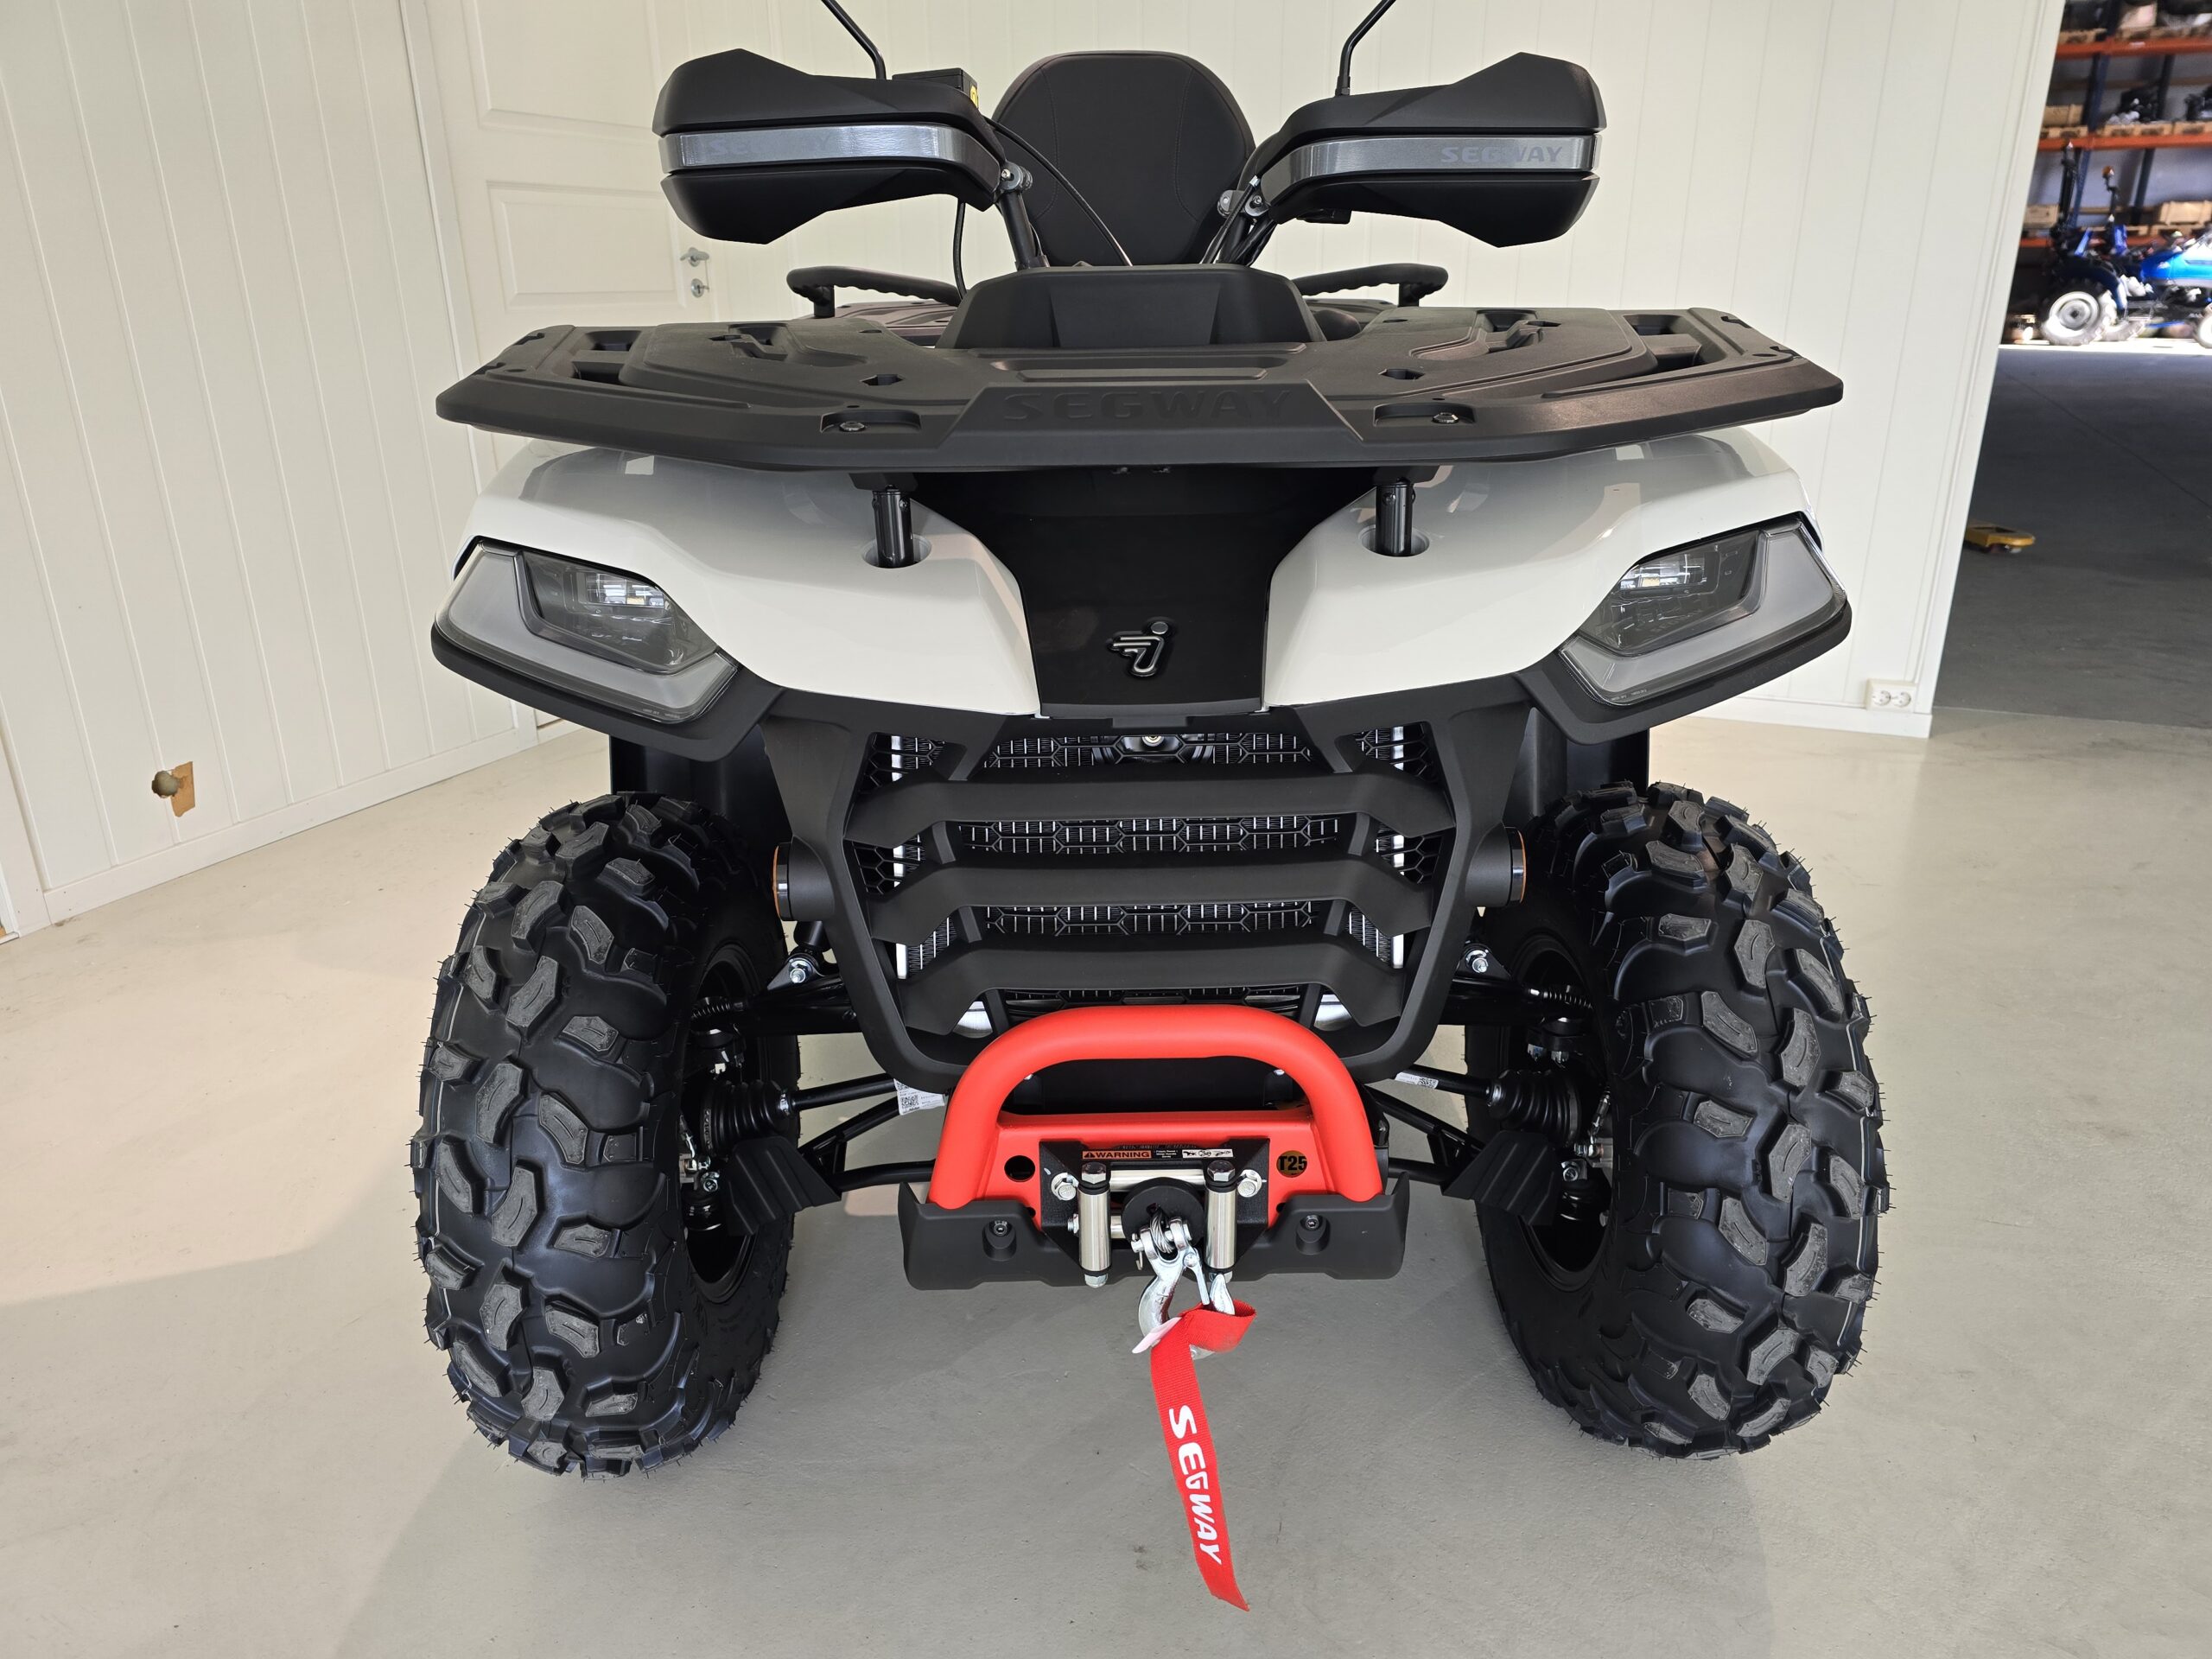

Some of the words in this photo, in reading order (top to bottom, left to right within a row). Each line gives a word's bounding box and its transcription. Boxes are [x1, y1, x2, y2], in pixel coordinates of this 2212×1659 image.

[1003, 389, 1291, 421] SEGWAY
[1278, 1155, 1307, 1171] T25
[1168, 1404, 1222, 1565] SEGWAY
